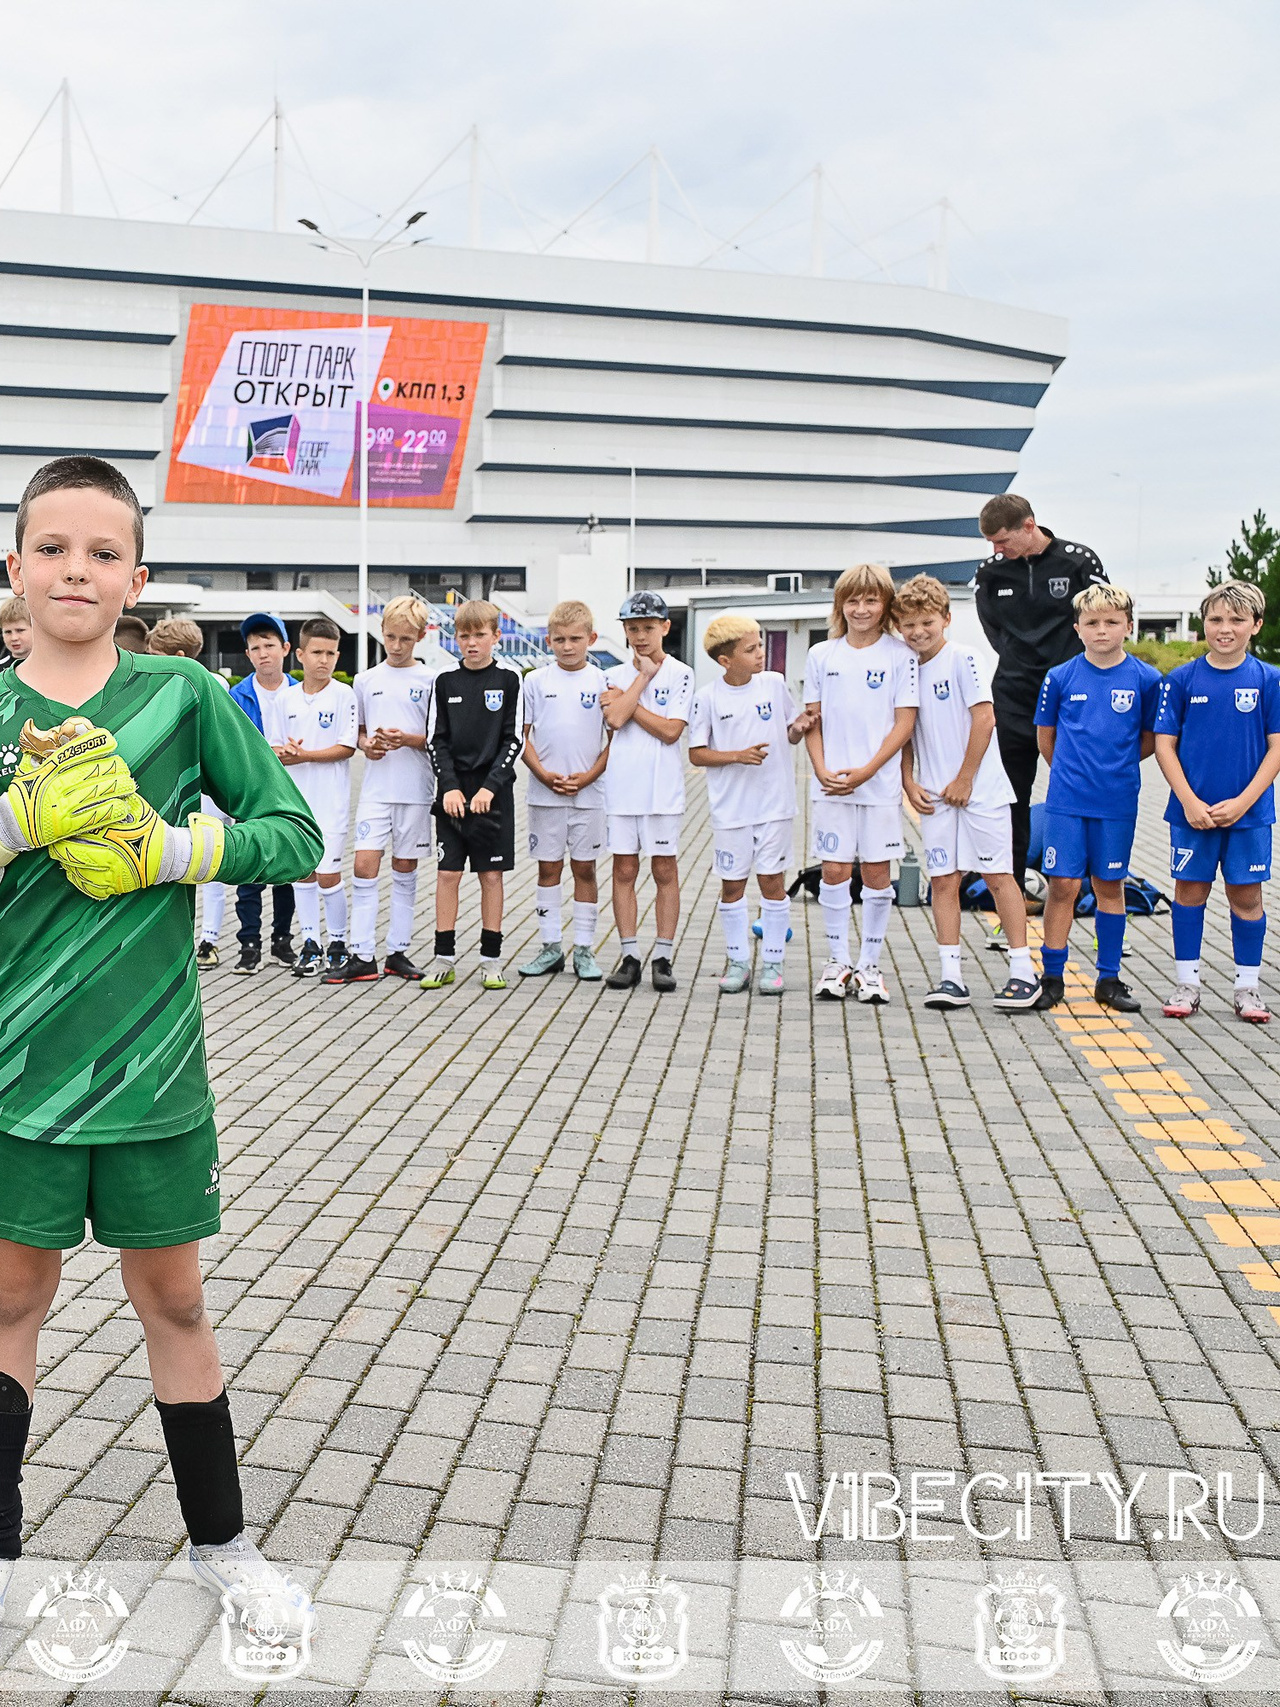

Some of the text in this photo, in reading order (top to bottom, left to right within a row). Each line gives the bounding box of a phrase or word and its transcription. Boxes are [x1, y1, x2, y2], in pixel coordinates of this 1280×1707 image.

[237, 341, 356, 381] СПОРТ ПАРК
[233, 380, 354, 408] ОТКРЫТ
[396, 382, 435, 400] КПП
[998, 588, 1013, 596] JAKO
[1070, 693, 1087, 701] JAKO
[1190, 696, 1208, 704] JAKO
[75, 735, 107, 755] SPORT
[1044, 846, 1056, 869] 8
[1107, 861, 1123, 869] JAKO
[1249, 864, 1266, 872] JAKO
